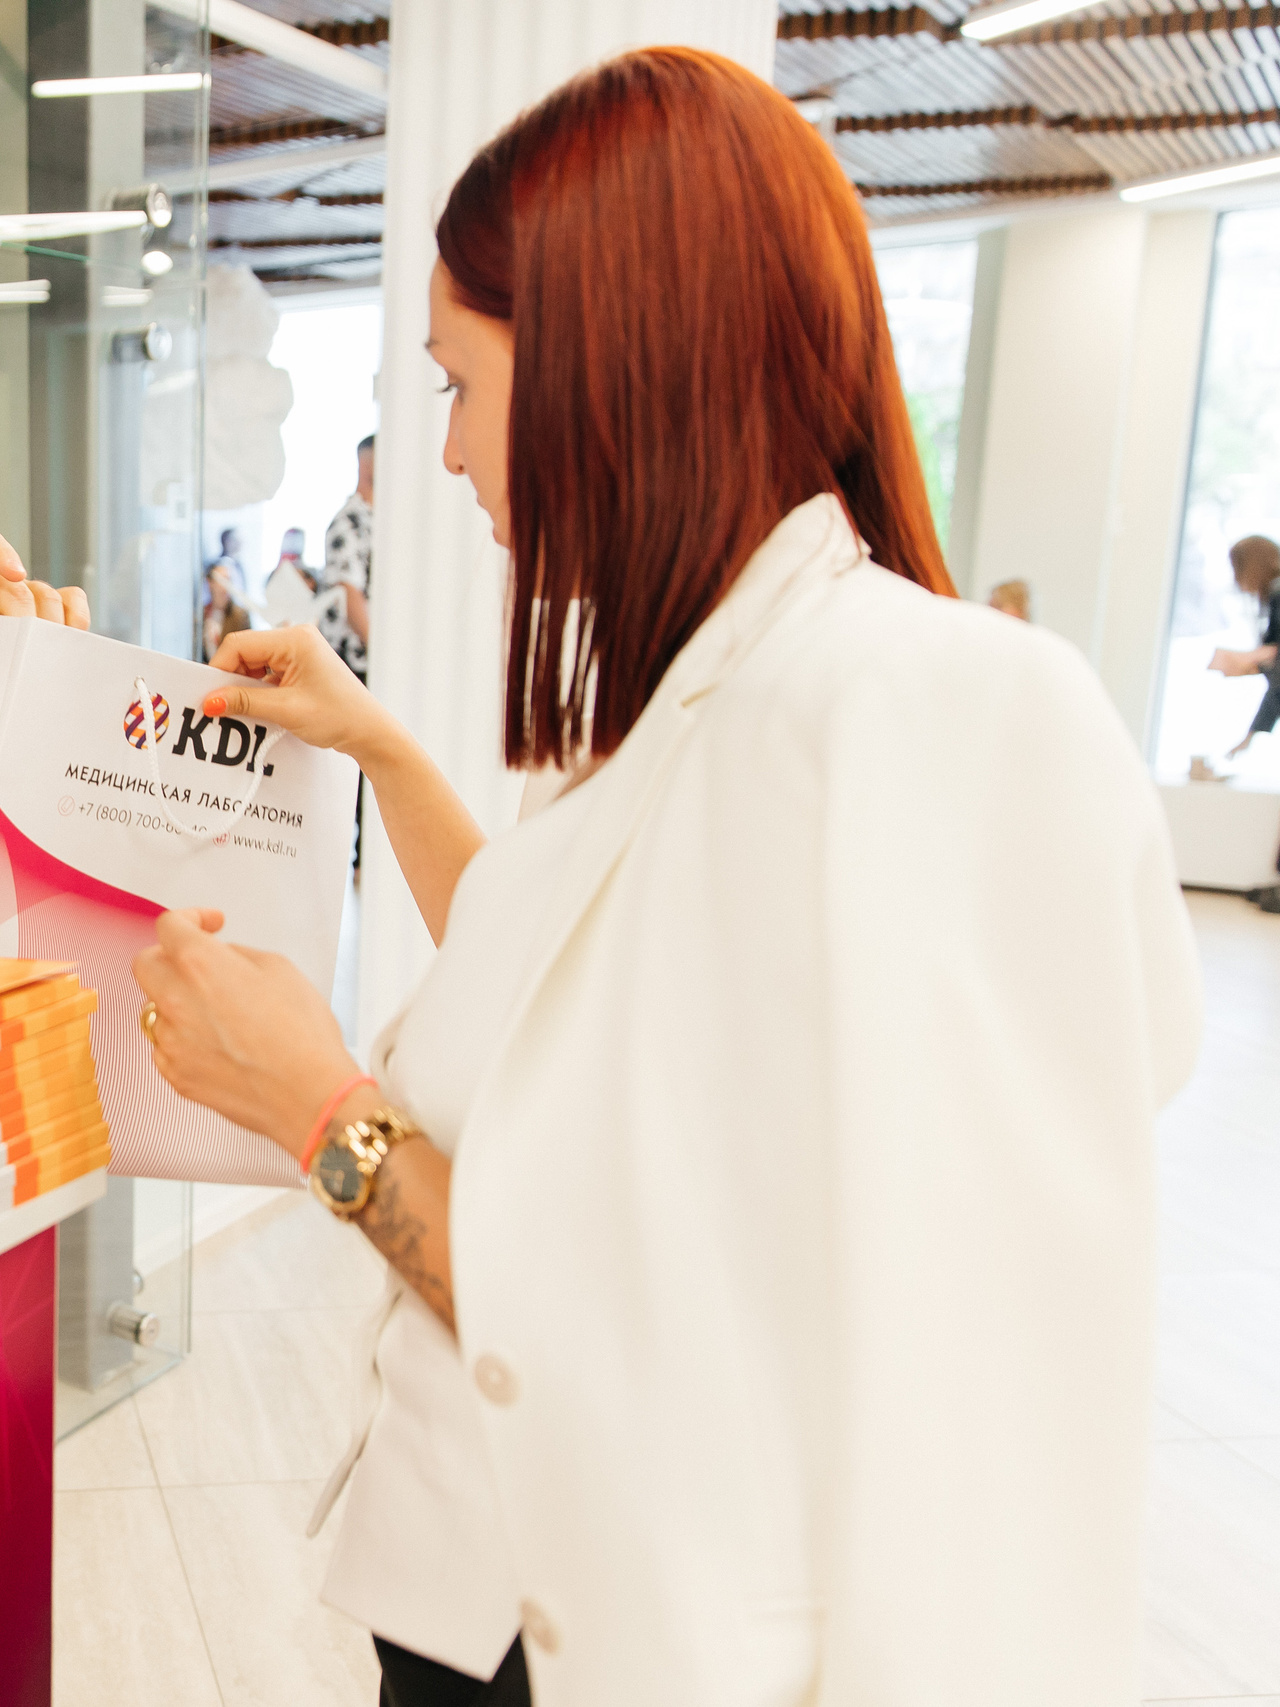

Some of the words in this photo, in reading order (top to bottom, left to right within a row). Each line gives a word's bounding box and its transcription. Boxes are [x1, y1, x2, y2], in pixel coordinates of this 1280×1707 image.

[171, 706, 275, 777] KDL
[78, 803, 94, 817] +7
[96, 805, 132, 828] (800)
[233, 833, 297, 859] www.kdl.ru
